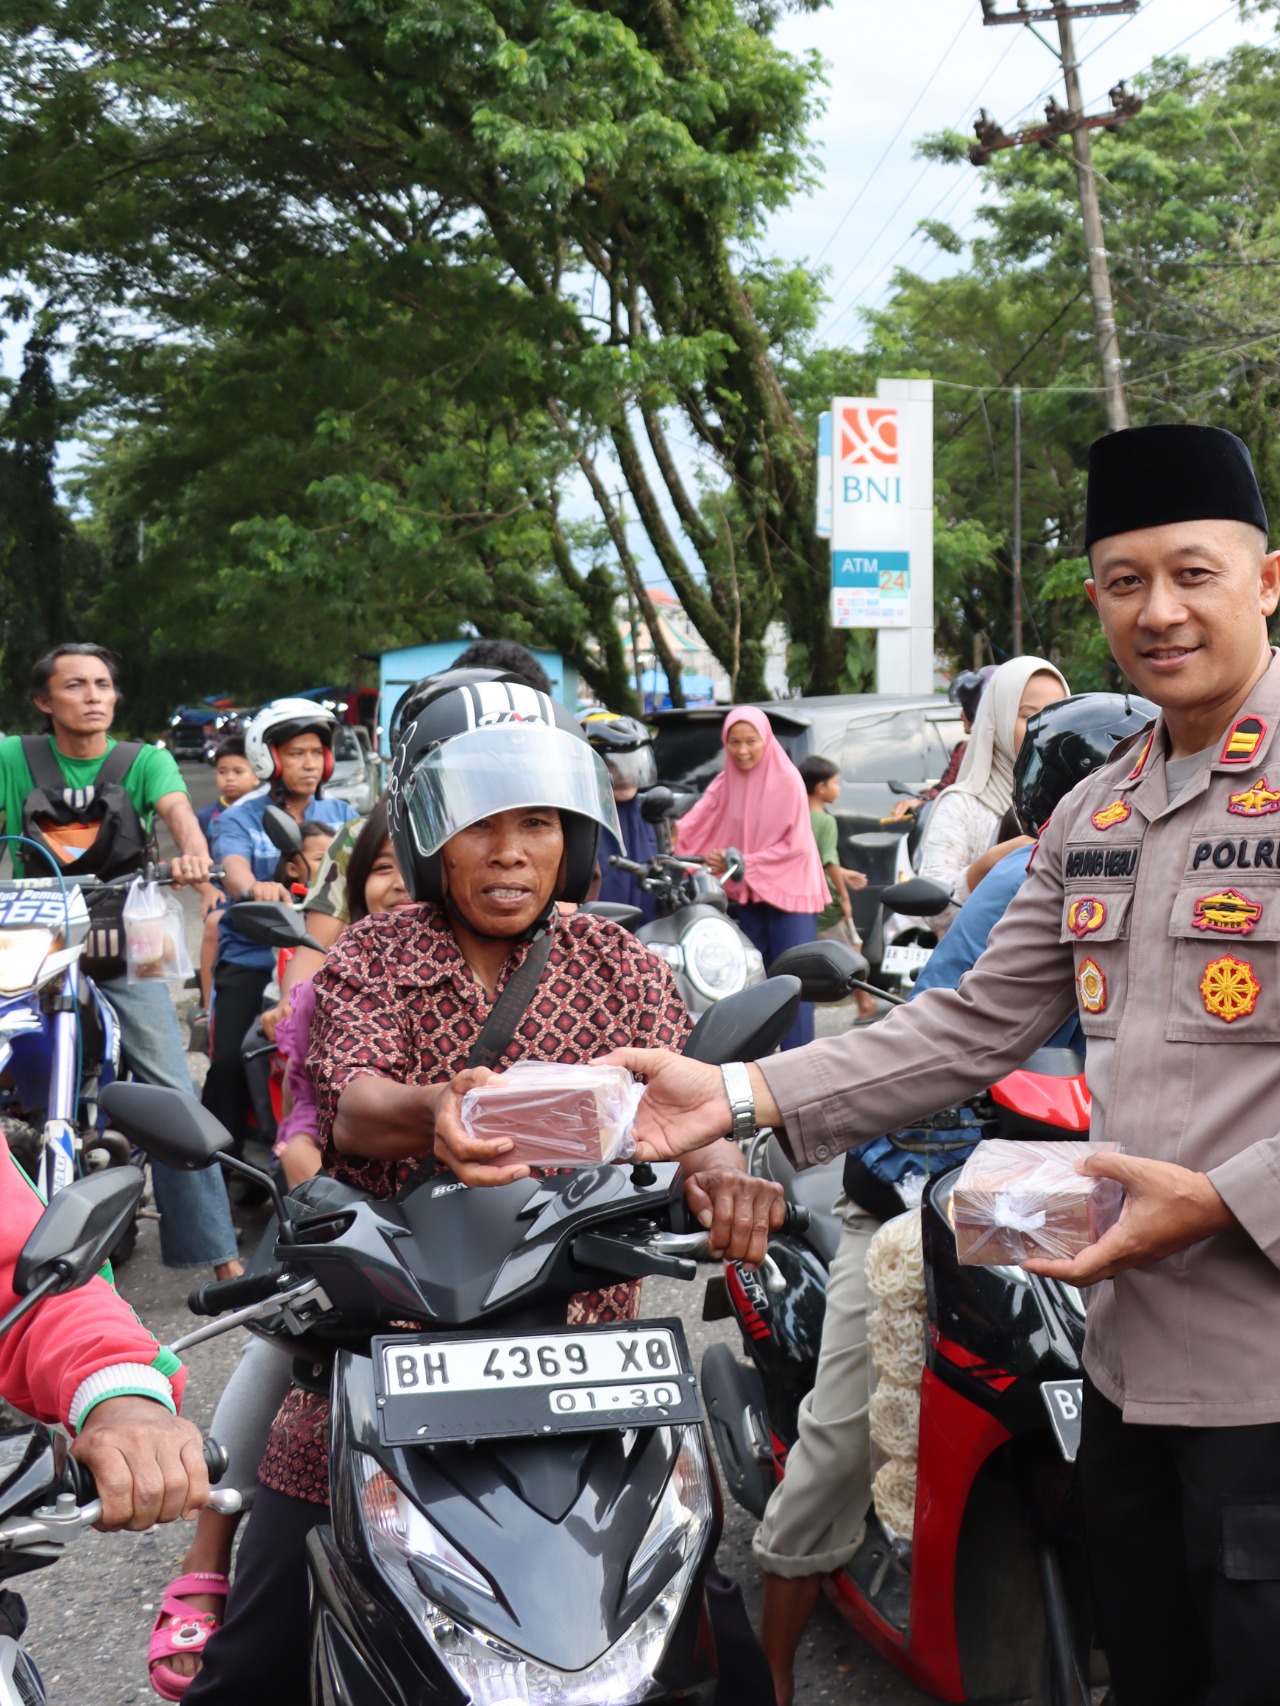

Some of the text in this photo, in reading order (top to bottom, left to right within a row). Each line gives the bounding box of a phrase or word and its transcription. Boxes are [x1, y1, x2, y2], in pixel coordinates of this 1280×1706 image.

[843, 475, 902, 504] BNI
[841, 557, 878, 573] ATM
[879, 571, 905, 590] 24
[1066, 848, 1138, 877] AGUNG HERU
[432, 1181, 469, 1197] HON
[395, 1352, 450, 1388] BH
[483, 1342, 589, 1381] 4369
[1054, 1388, 1083, 1420] B
